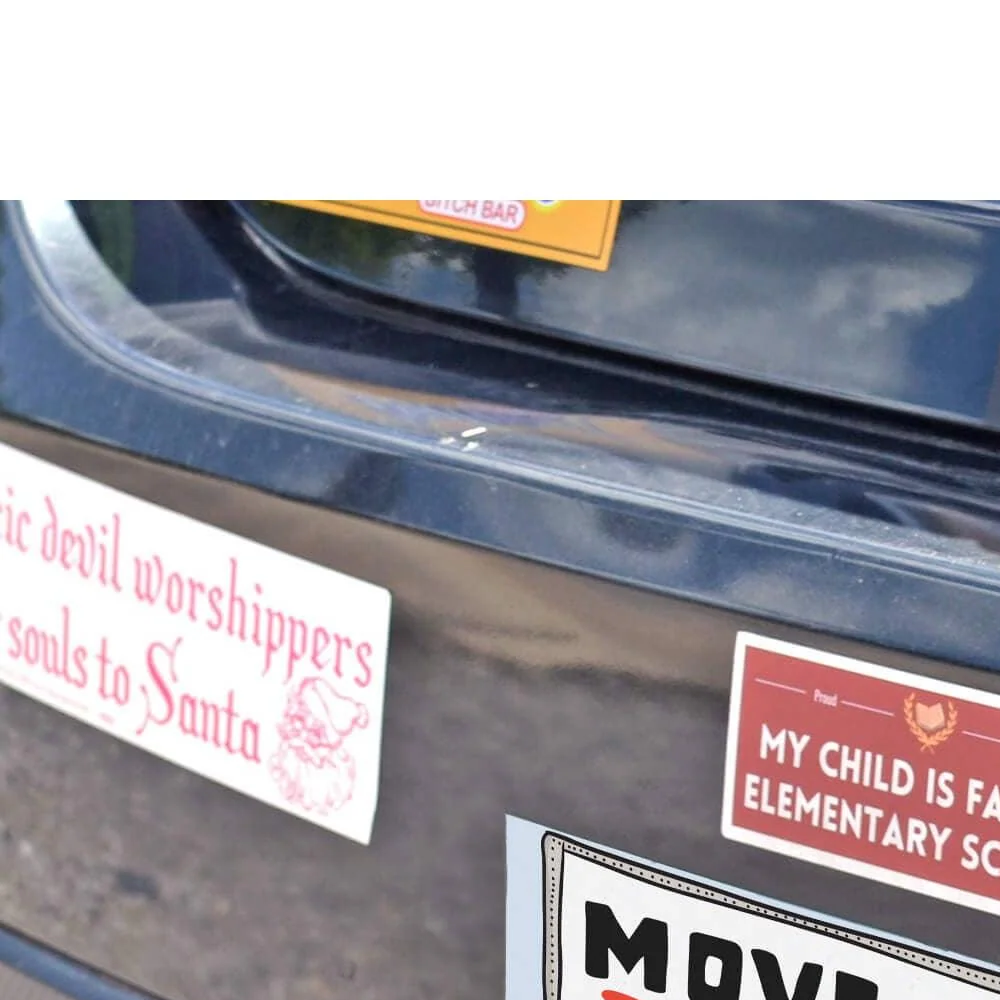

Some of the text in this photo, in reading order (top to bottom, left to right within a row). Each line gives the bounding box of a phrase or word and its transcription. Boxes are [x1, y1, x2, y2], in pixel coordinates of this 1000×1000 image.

[482, 200, 518, 225] BAR
[0, 486, 373, 690] ic devil worshippers
[8, 606, 88, 688] souls
[97, 637, 130, 706] to
[136, 637, 261, 764] Santa
[760, 723, 811, 769] MY
[819, 740, 915, 797] CHILD
[926, 767, 955, 809] IS
[743, 773, 953, 861] ELEMENTARY
